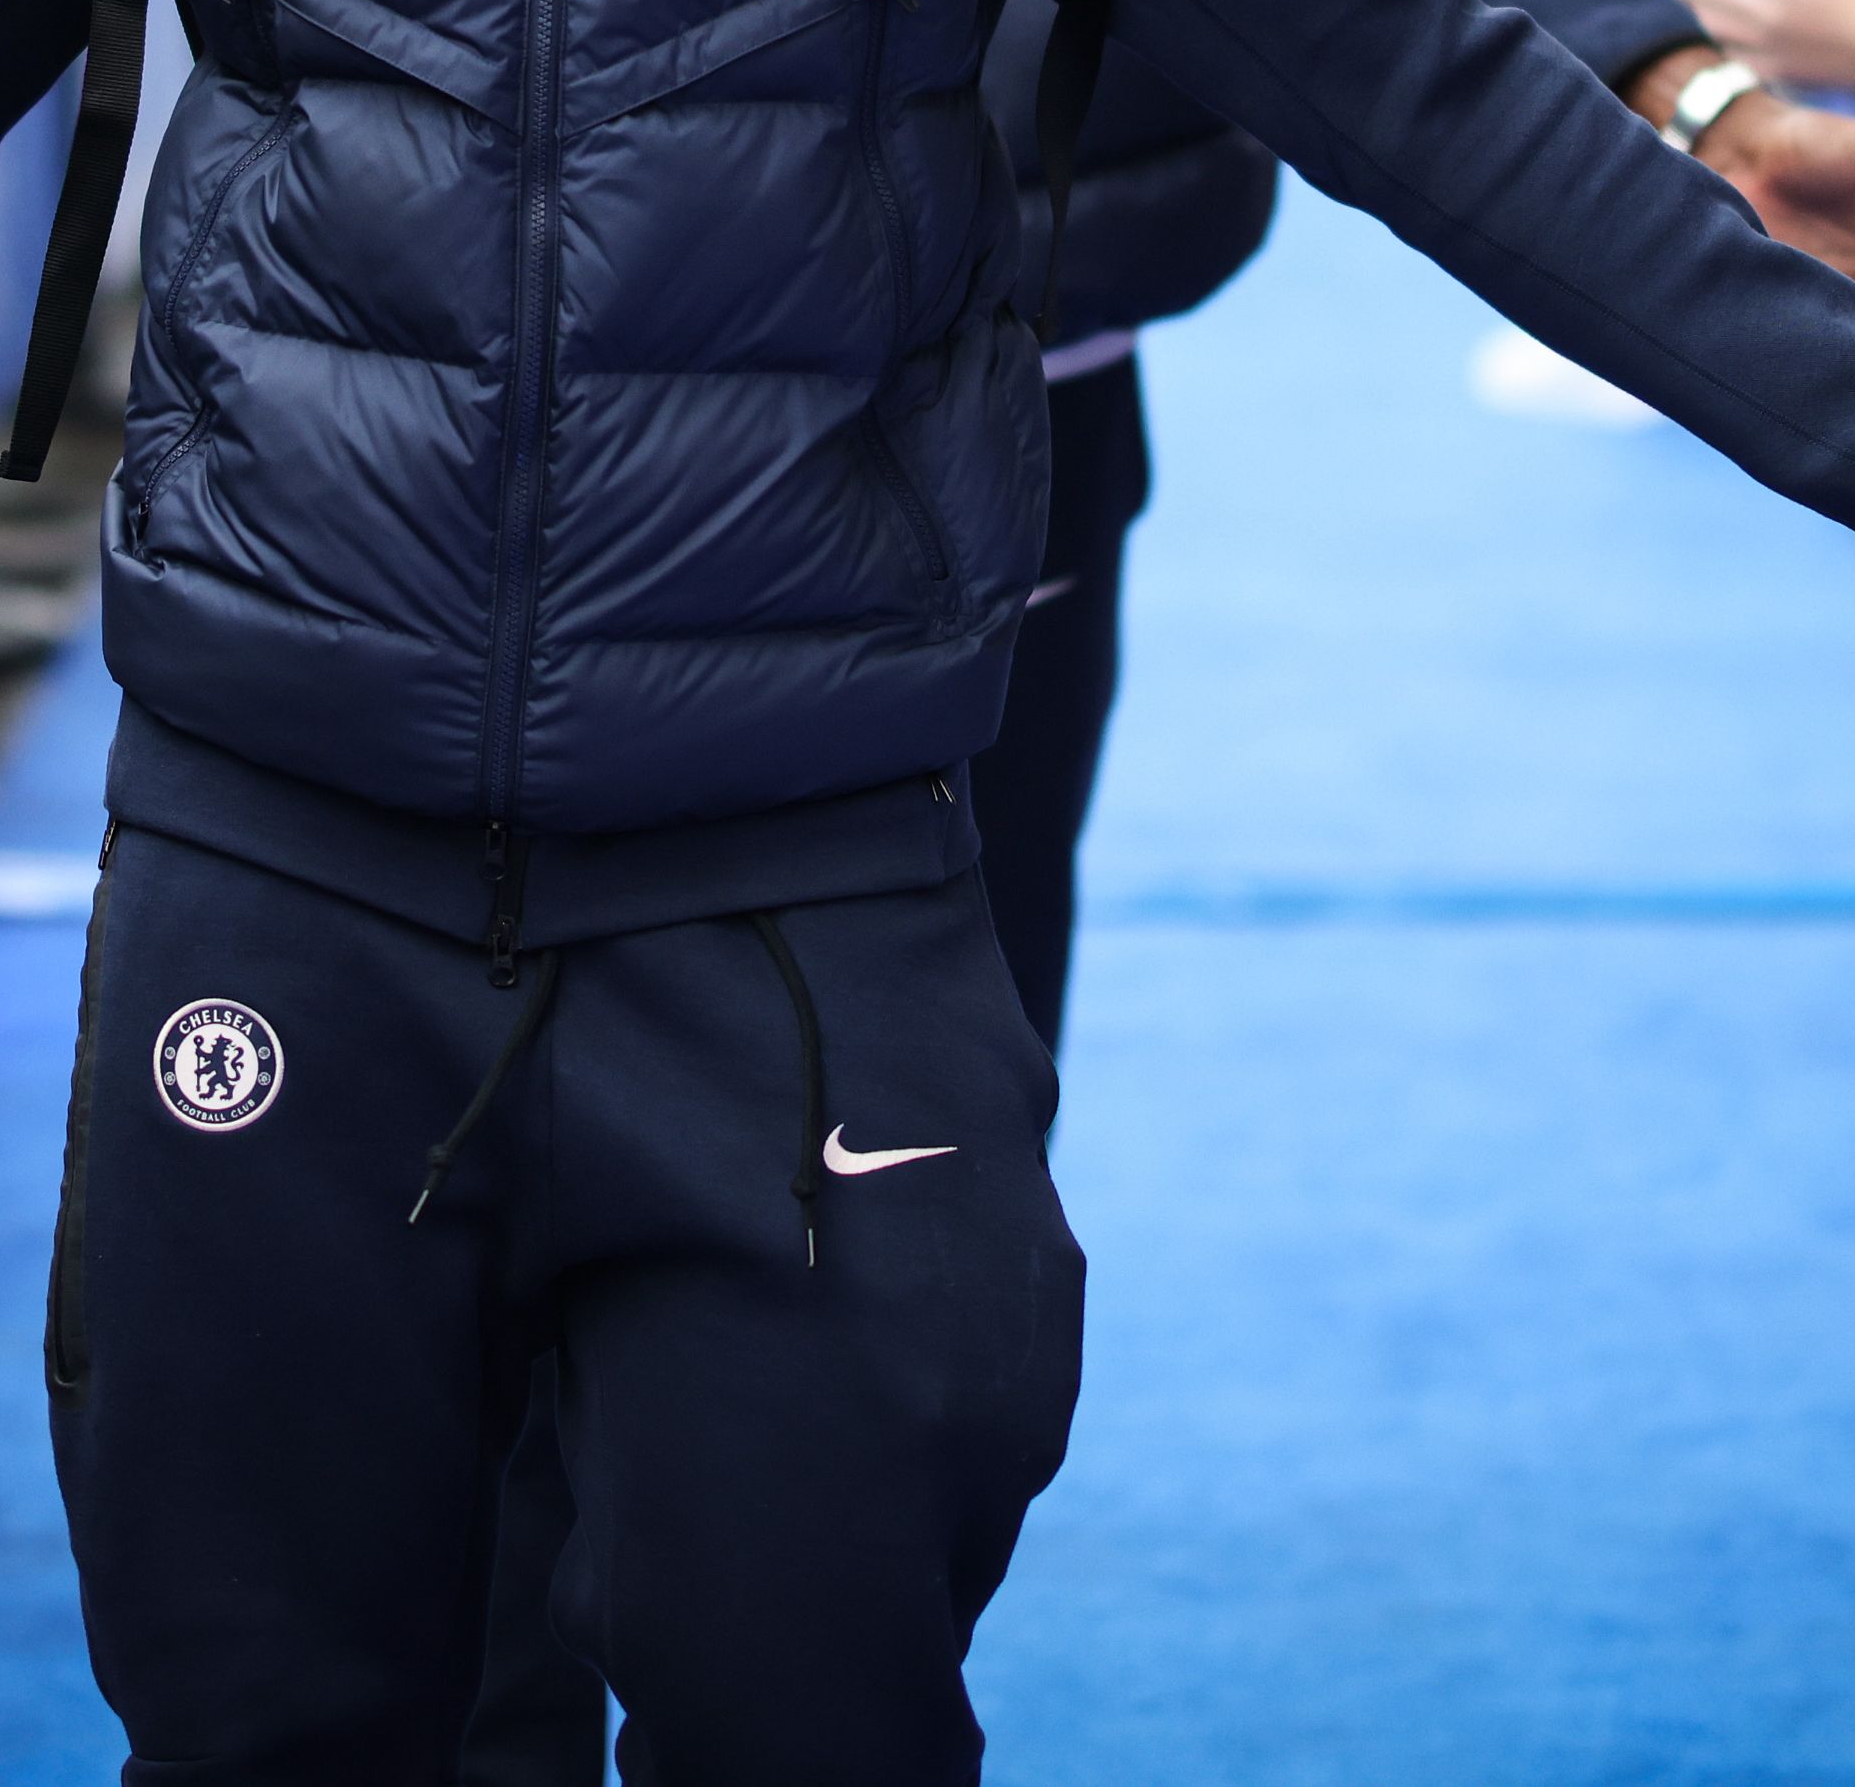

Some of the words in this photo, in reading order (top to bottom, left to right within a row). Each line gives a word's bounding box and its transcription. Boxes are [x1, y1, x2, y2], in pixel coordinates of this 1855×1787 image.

[179, 1009, 254, 1036] CHELSEA
[176, 1099, 227, 1122] FOOTBALL
[230, 1099, 256, 1118] CLUB
